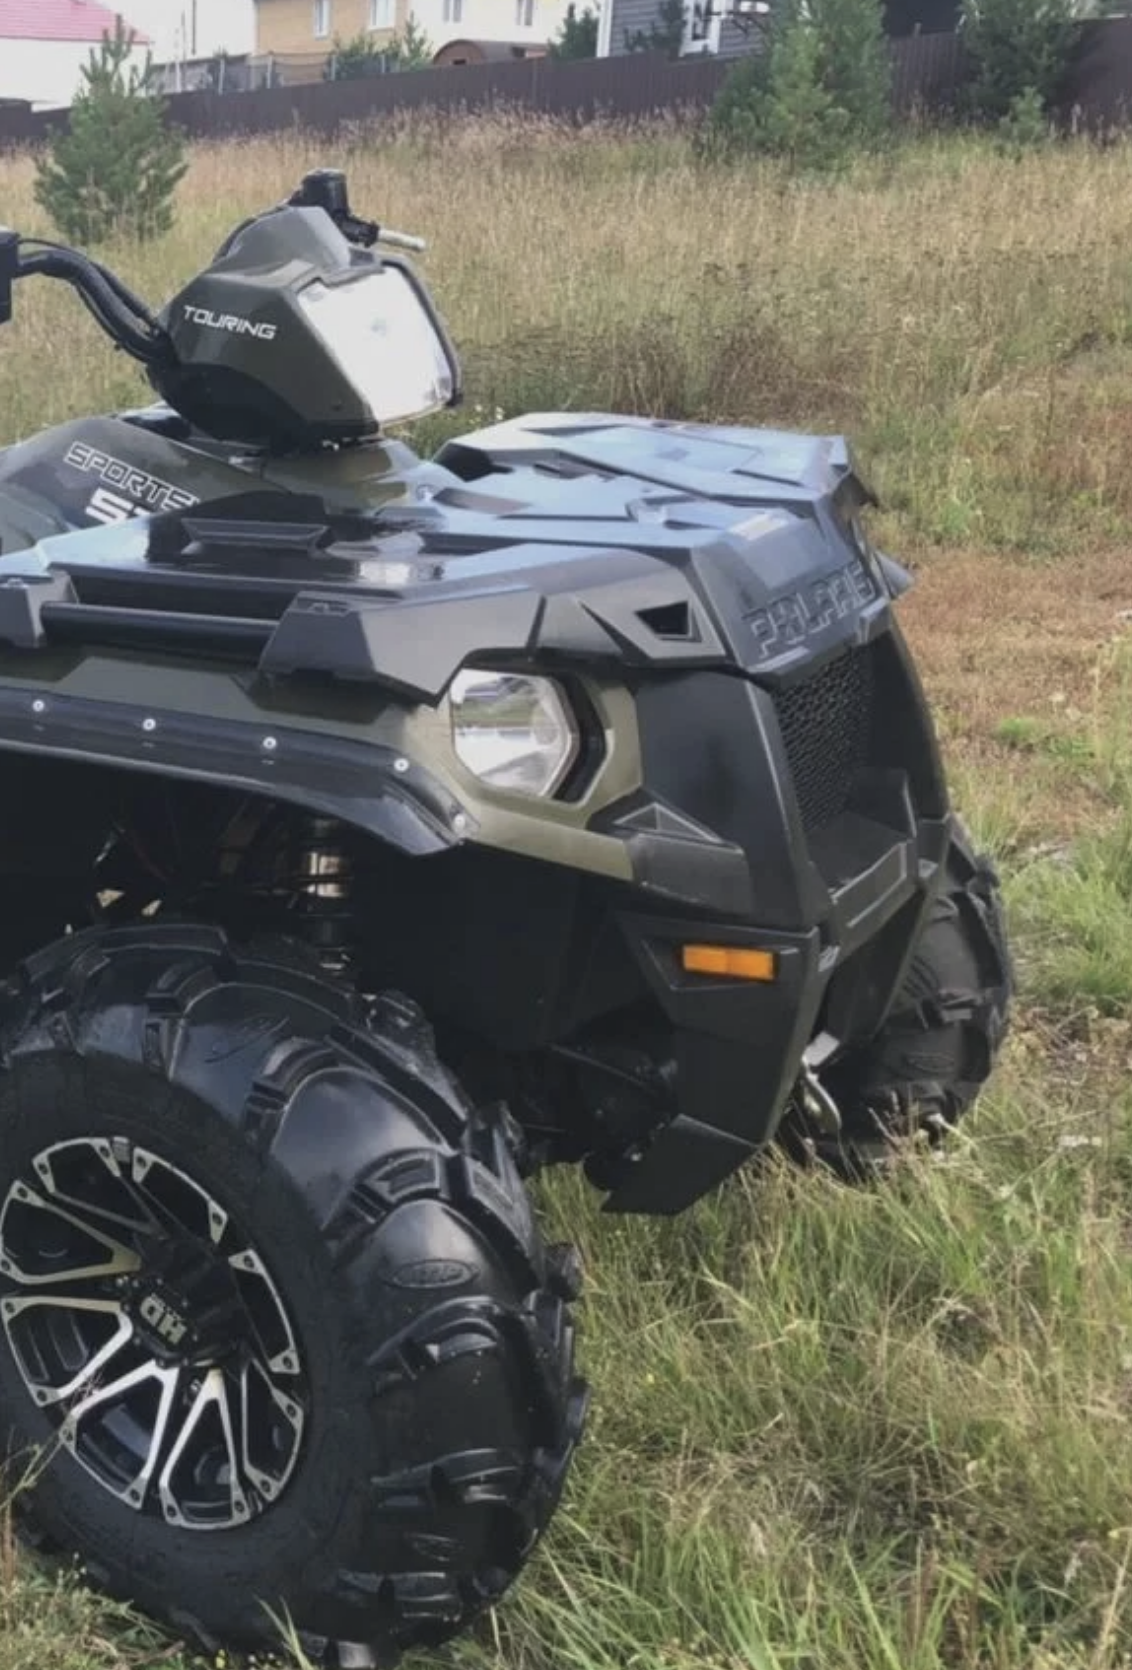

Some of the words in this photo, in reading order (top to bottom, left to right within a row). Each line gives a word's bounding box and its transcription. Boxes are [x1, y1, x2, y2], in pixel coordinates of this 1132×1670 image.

[183, 304, 277, 340] TOURING
[63, 441, 200, 511] SPORTS
[742, 559, 875, 658] POLARIS
[139, 1293, 188, 1344] HD
